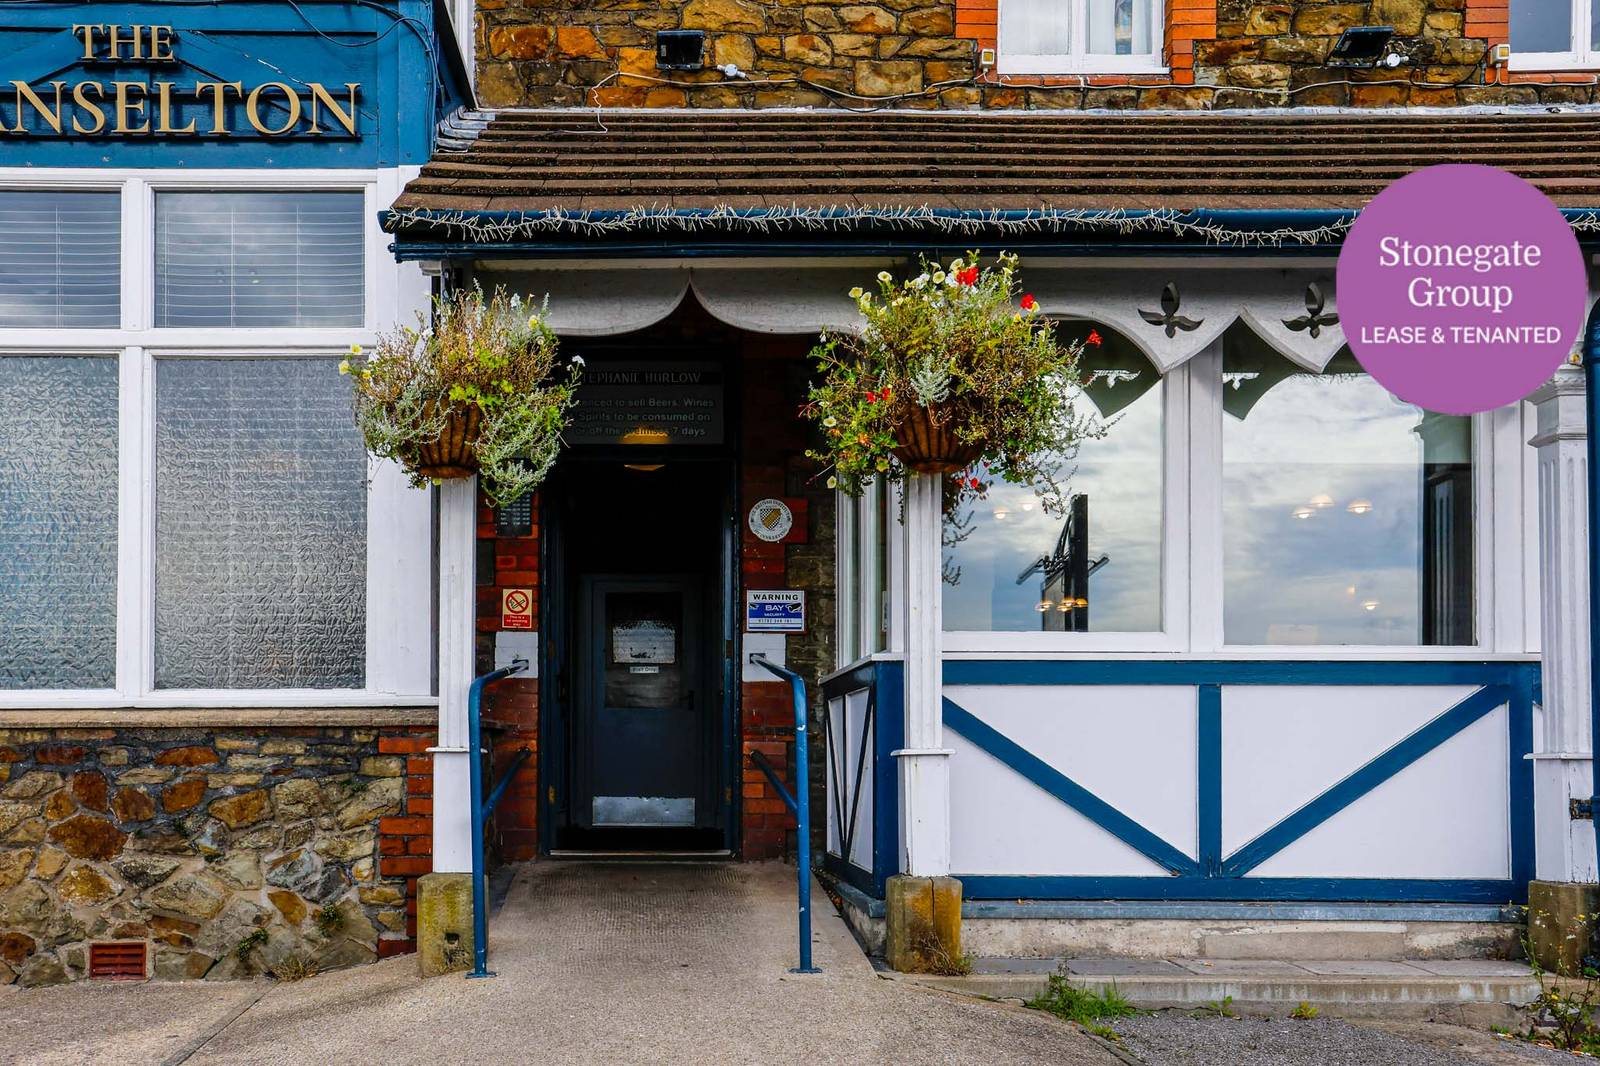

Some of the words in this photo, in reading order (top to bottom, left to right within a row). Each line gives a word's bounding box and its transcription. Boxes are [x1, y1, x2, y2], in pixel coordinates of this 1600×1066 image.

[72, 24, 174, 61] THE
[0, 80, 361, 135] NSELTON
[583, 372, 640, 383] TEPHANIE
[645, 372, 701, 383] HURLOW
[641, 412, 695, 422] consumed
[697, 413, 711, 422] on
[682, 426, 706, 439] days
